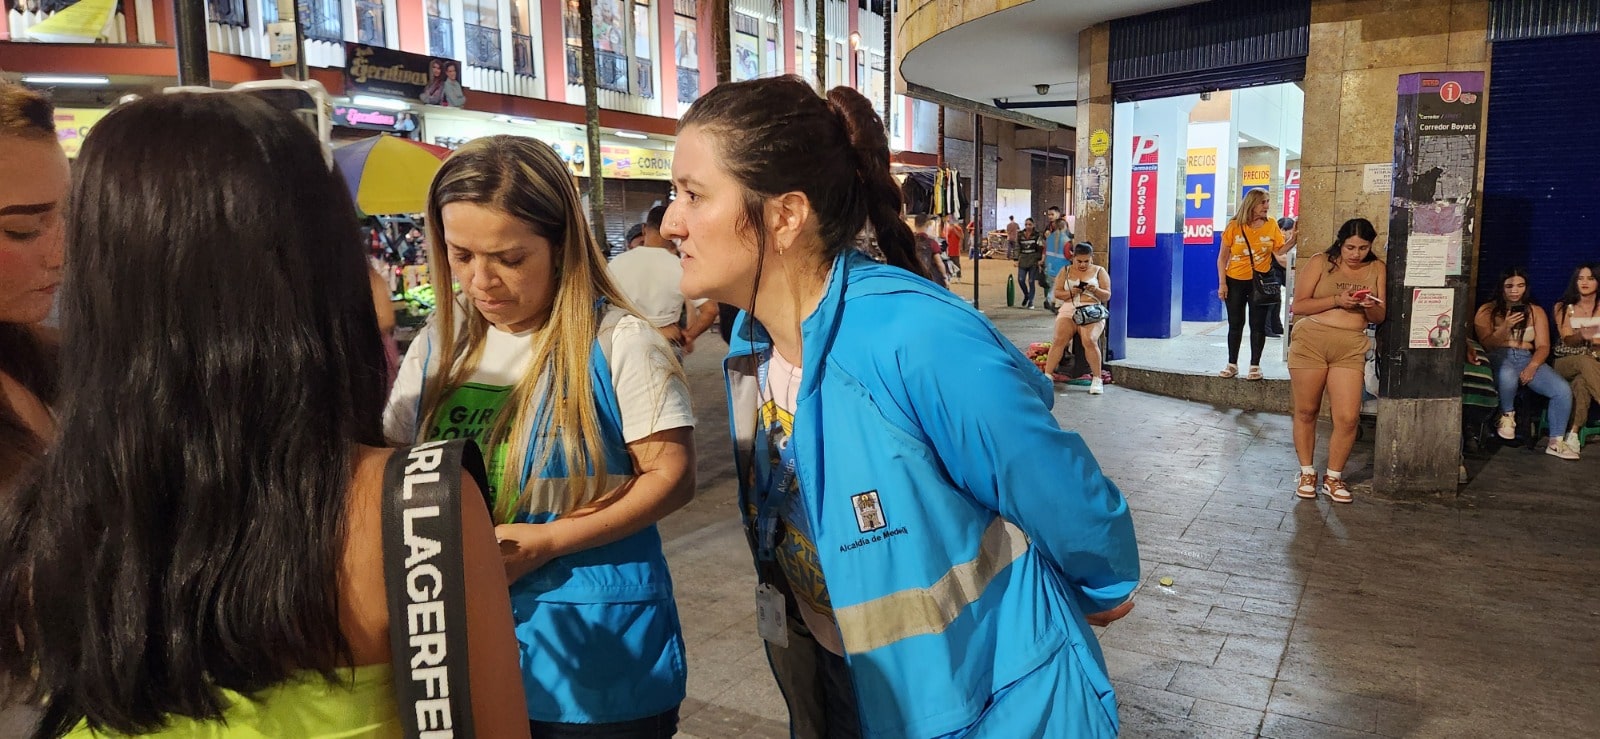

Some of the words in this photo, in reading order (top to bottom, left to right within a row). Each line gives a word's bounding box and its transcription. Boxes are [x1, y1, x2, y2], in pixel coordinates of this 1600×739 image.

[1420, 123, 1449, 131] Corredor
[1451, 123, 1477, 132] Boyacá
[1186, 155, 1216, 167] RECIOS
[1243, 170, 1270, 181] PRECIOS
[839, 537, 871, 553] Alcaldía
[871, 534, 882, 543] de
